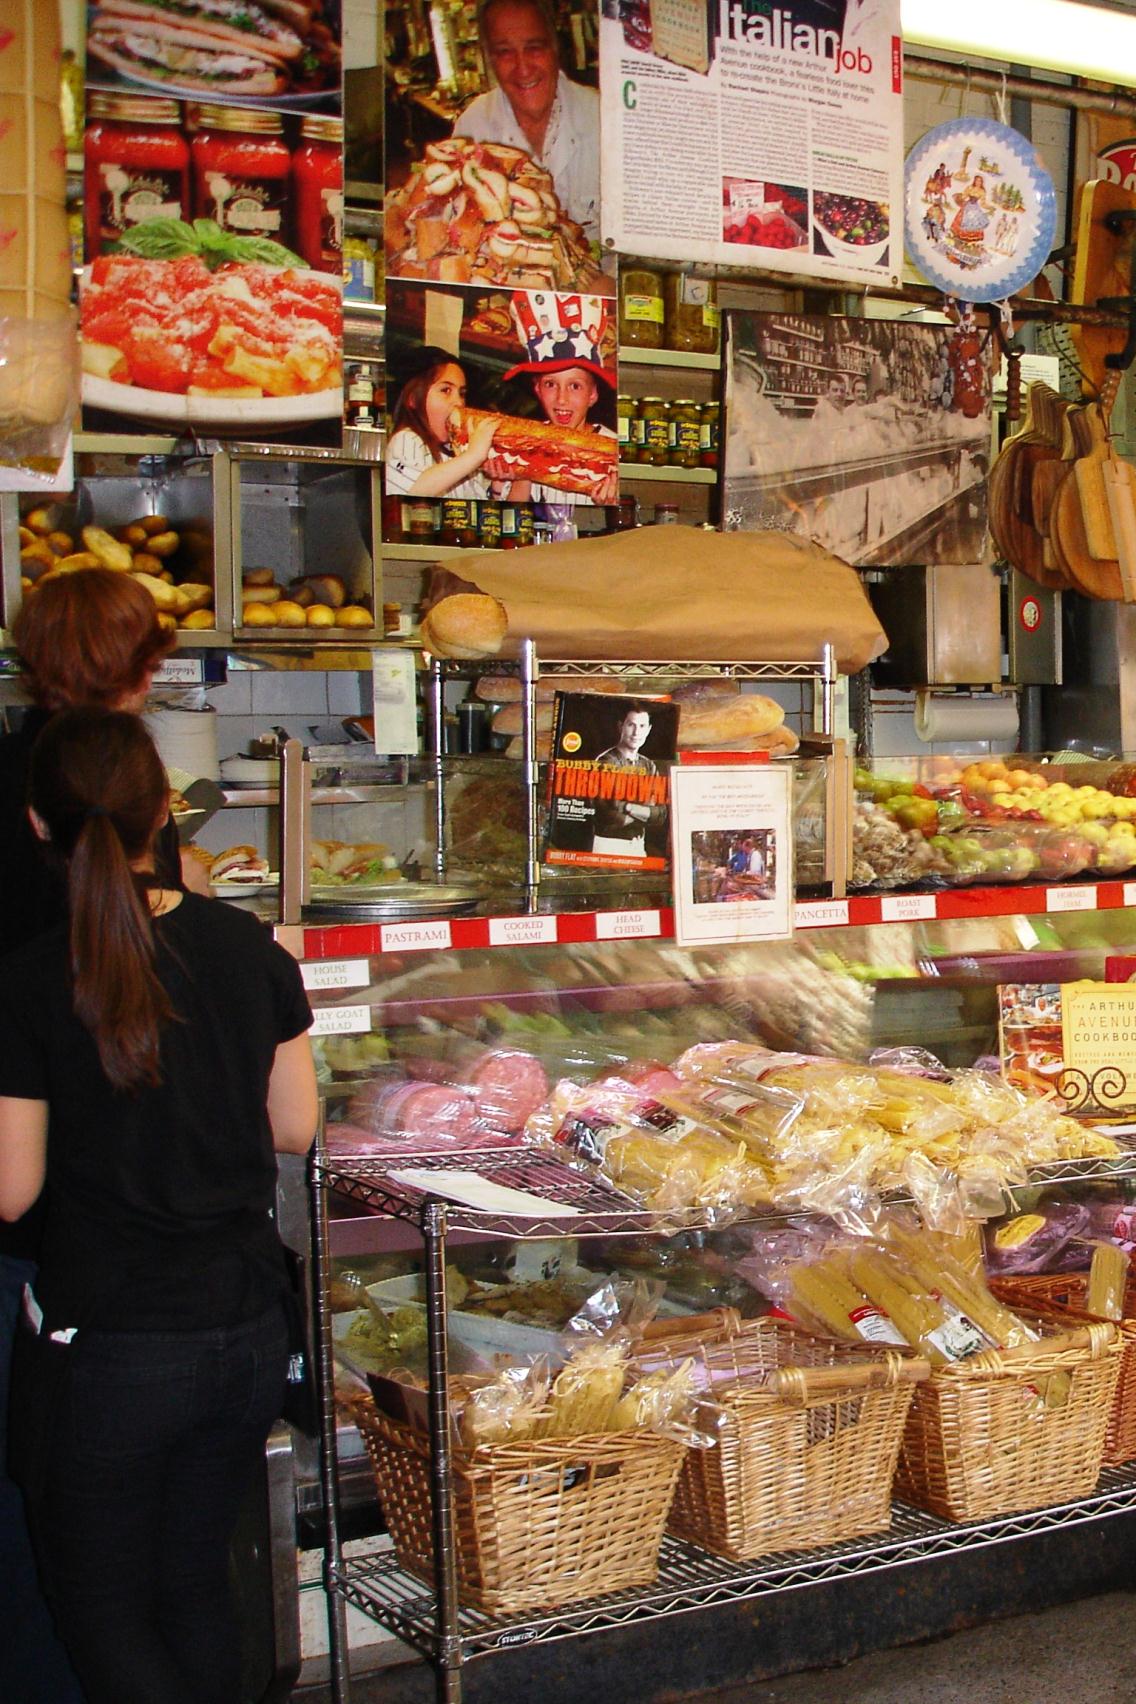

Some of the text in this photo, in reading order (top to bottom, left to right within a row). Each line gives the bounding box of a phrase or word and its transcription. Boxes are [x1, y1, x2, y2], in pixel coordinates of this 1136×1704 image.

[719, 0, 839, 59] Italian
[740, 48, 752, 57] the
[754, 51, 770, 62] help
[772, 55, 780, 64] of
[789, 58, 803, 67] new
[834, 47, 873, 74] job
[623, 80, 637, 110] C
[555, 758, 602, 772] BOBBY
[554, 767, 668, 805] THROWDOWN
[558, 798, 584, 807] More Than
[558, 805, 596, 815] 100 Recipes
[896, 899, 922, 908] ROAST
[616, 914, 642, 923] HEAD
[794, 908, 847, 921] PANCETTA
[898, 909, 920, 917] PORK
[503, 920, 544, 930] COOKED
[613, 924, 646, 935] CHEESE
[385, 930, 447, 943] PASTRAMI
[506, 931, 542, 941] SALAMI
[313, 964, 348, 975] HOUSE
[314, 977, 348, 986] SALAD
[335, 1008, 364, 1019] GOAT
[319, 1021, 353, 1031] SALAD
